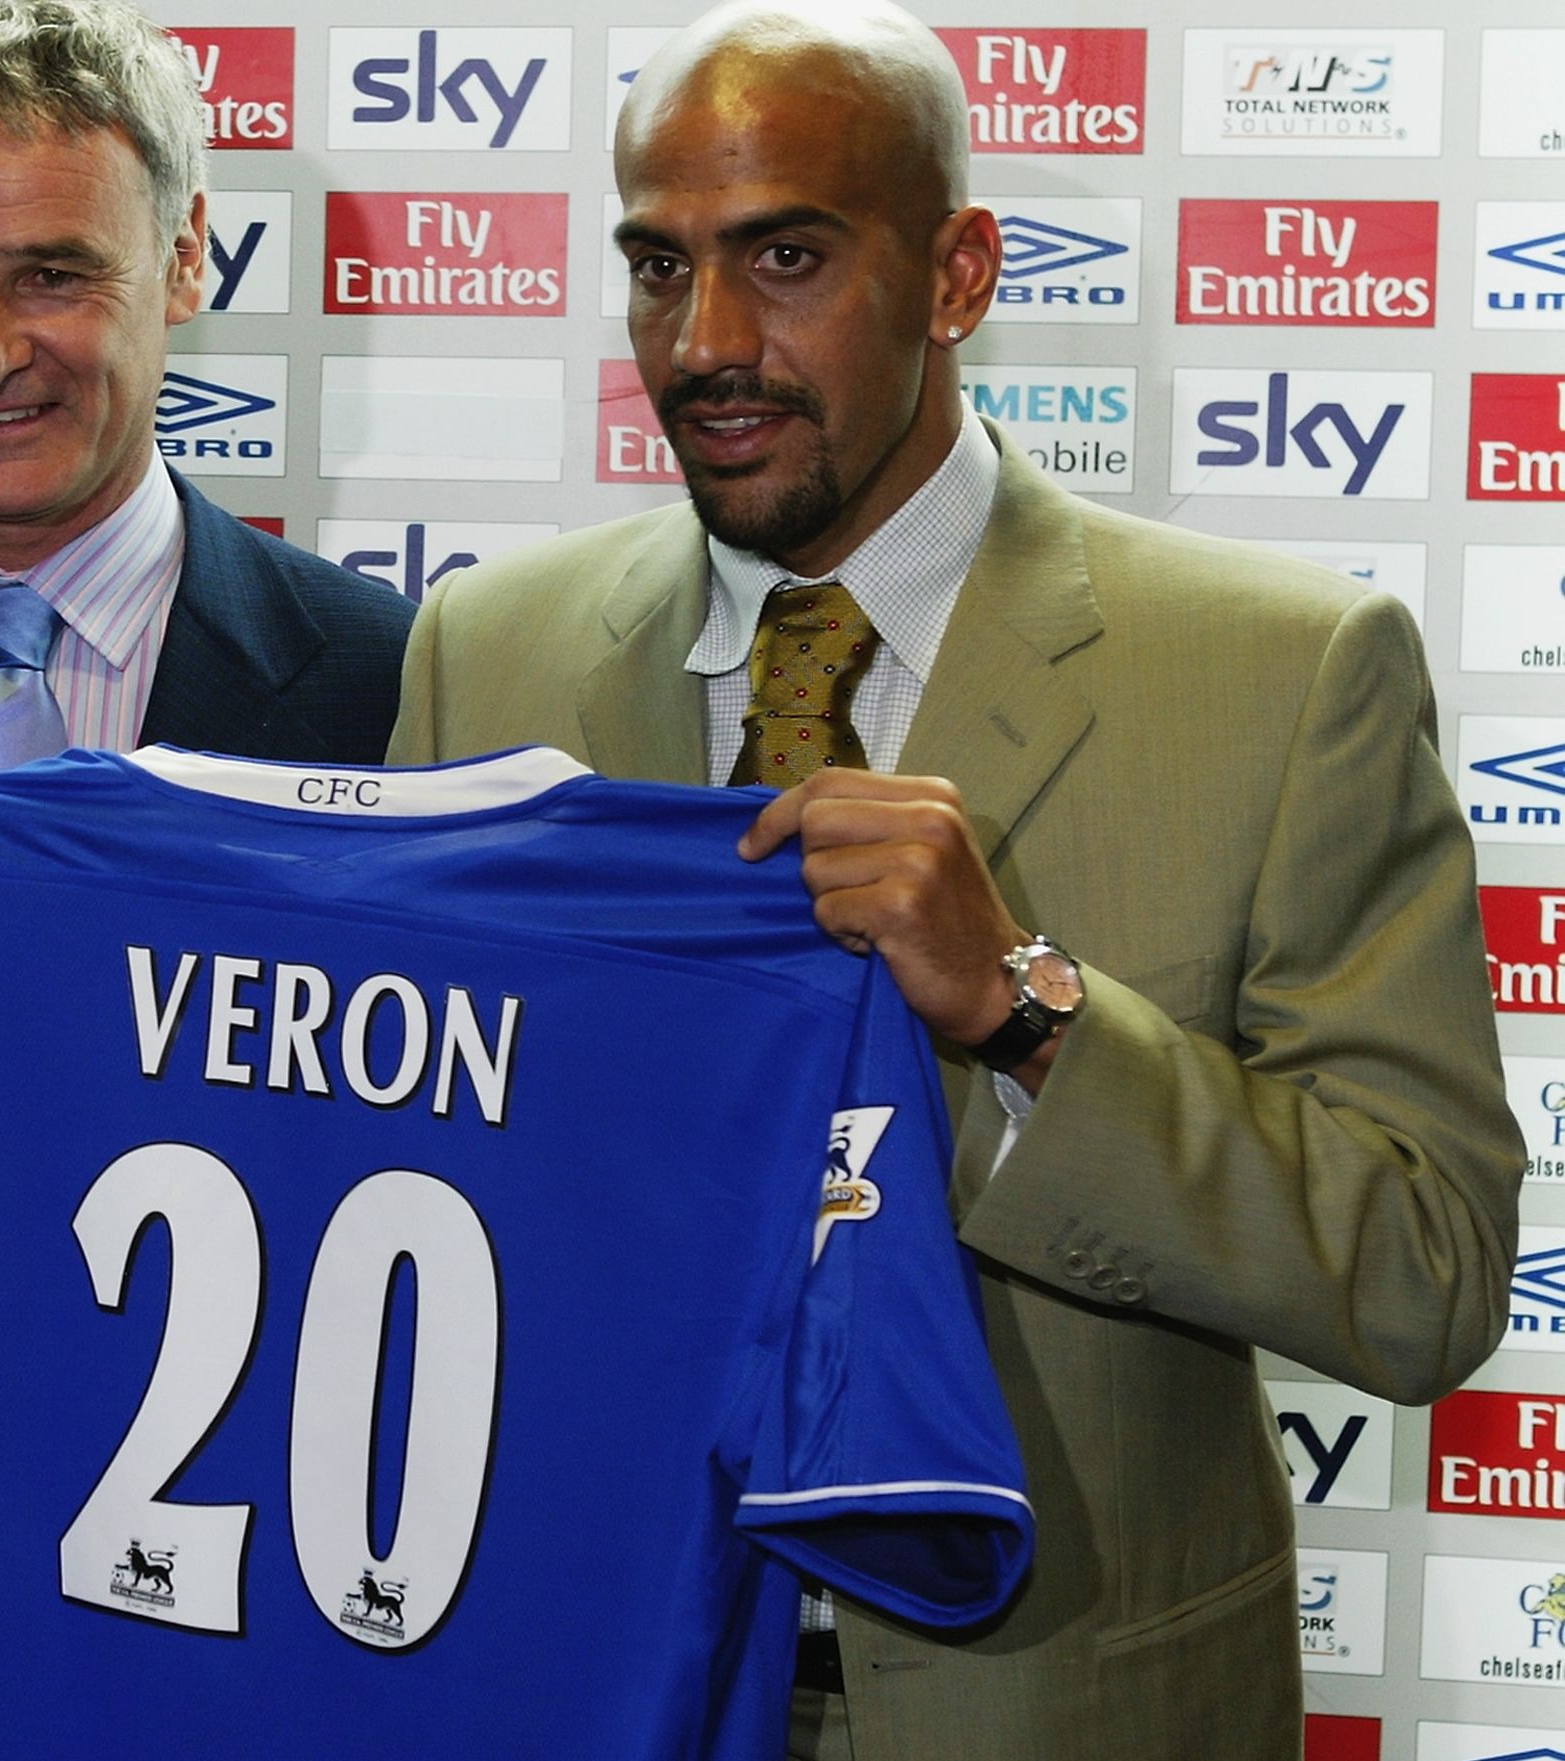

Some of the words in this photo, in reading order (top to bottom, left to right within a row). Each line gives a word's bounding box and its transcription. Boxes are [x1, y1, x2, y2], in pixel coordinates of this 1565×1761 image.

[352, 30, 547, 148] sky
[976, 35, 1067, 95] Fly
[1223, 117, 1392, 134] SOLUTIONS
[1225, 100, 1285, 113] TOTAL
[1293, 100, 1390, 114] NETWORK
[405, 201, 491, 258] Fly
[1263, 207, 1357, 267] Fly
[335, 256, 560, 306] Emirates
[997, 285, 1125, 305] BRO
[1186, 265, 1430, 319] Emirates
[965, 384, 1128, 423] MENS
[155, 438, 272, 458] BRO
[1028, 441, 1126, 474] obile
[1197, 372, 1405, 495] sky
[296, 777, 381, 807] CFC
[125, 944, 521, 1125] VERON
[59, 1141, 501, 1652] 20
